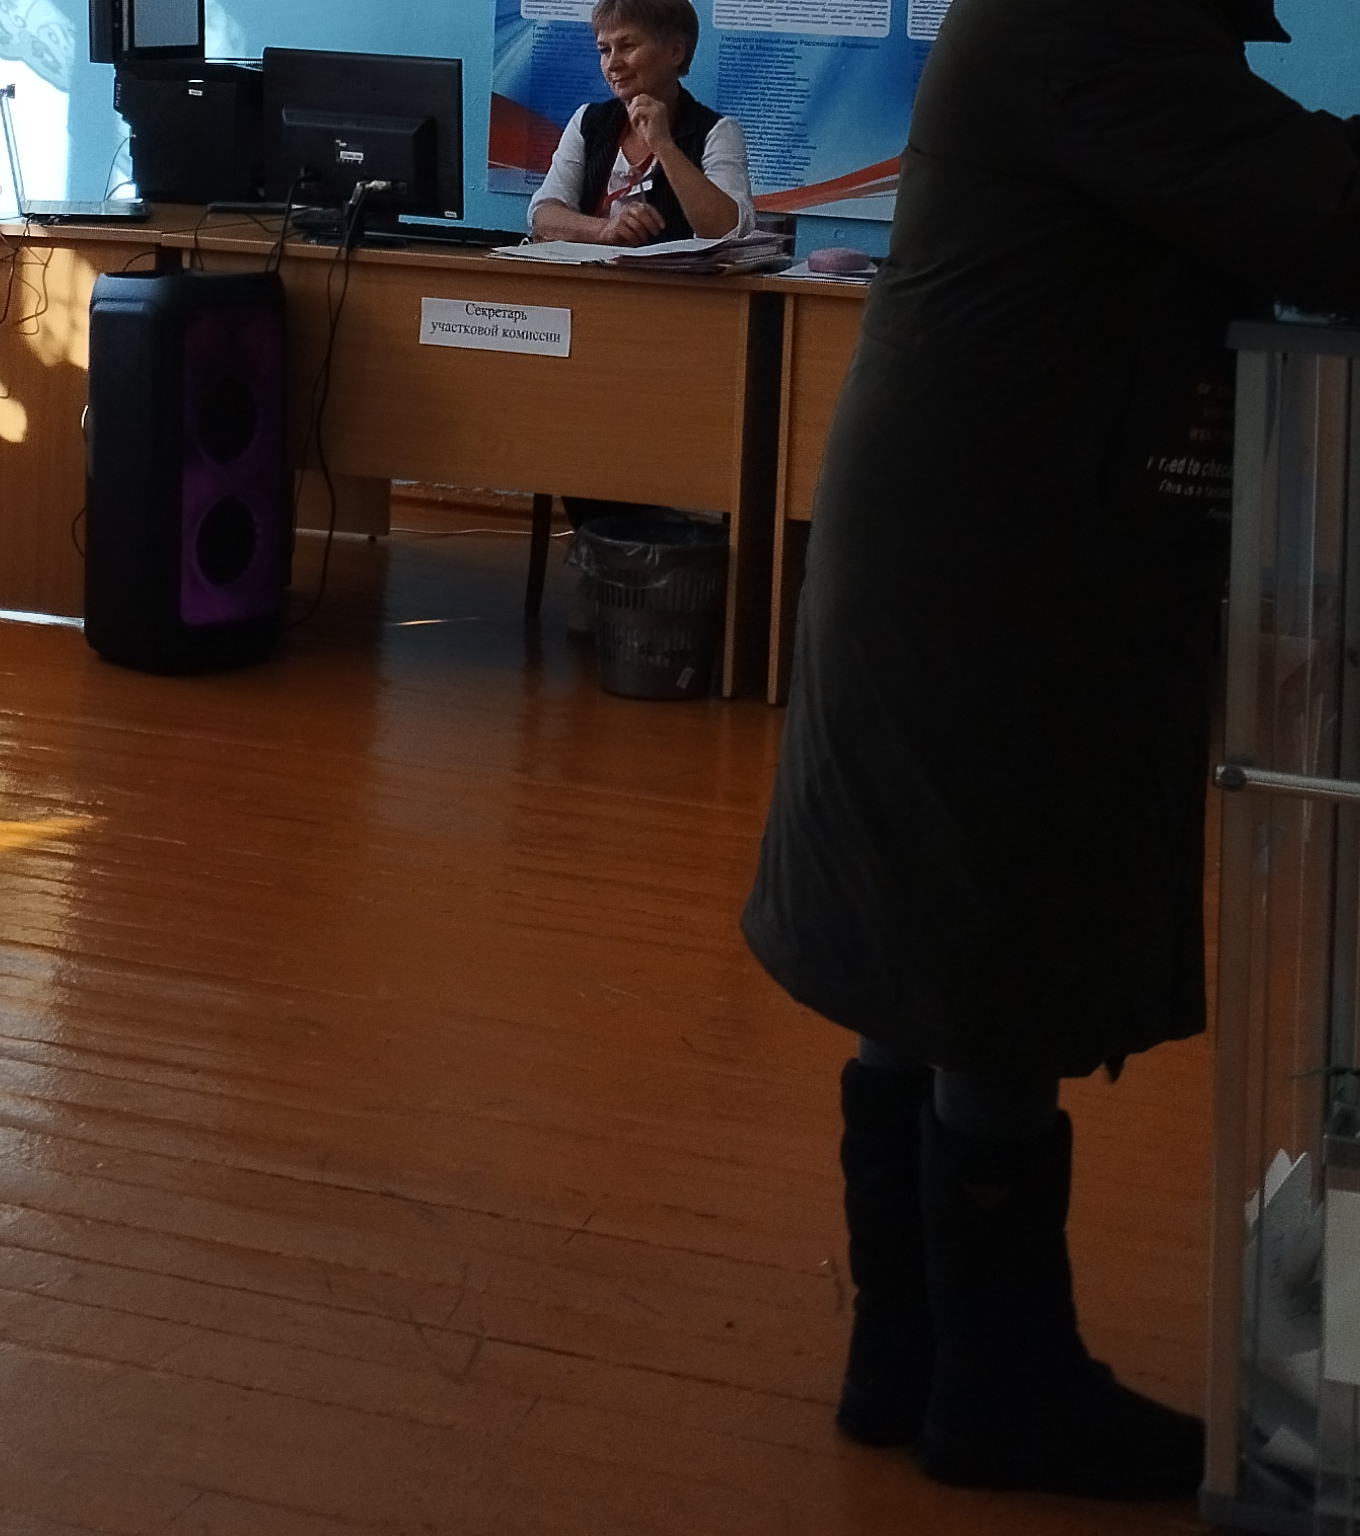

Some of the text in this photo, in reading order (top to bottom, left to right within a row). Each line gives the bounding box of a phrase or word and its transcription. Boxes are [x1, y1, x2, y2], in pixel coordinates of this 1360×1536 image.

[465, 302, 528, 323] Секретарь
[430, 320, 561, 343] участковой комиссии
